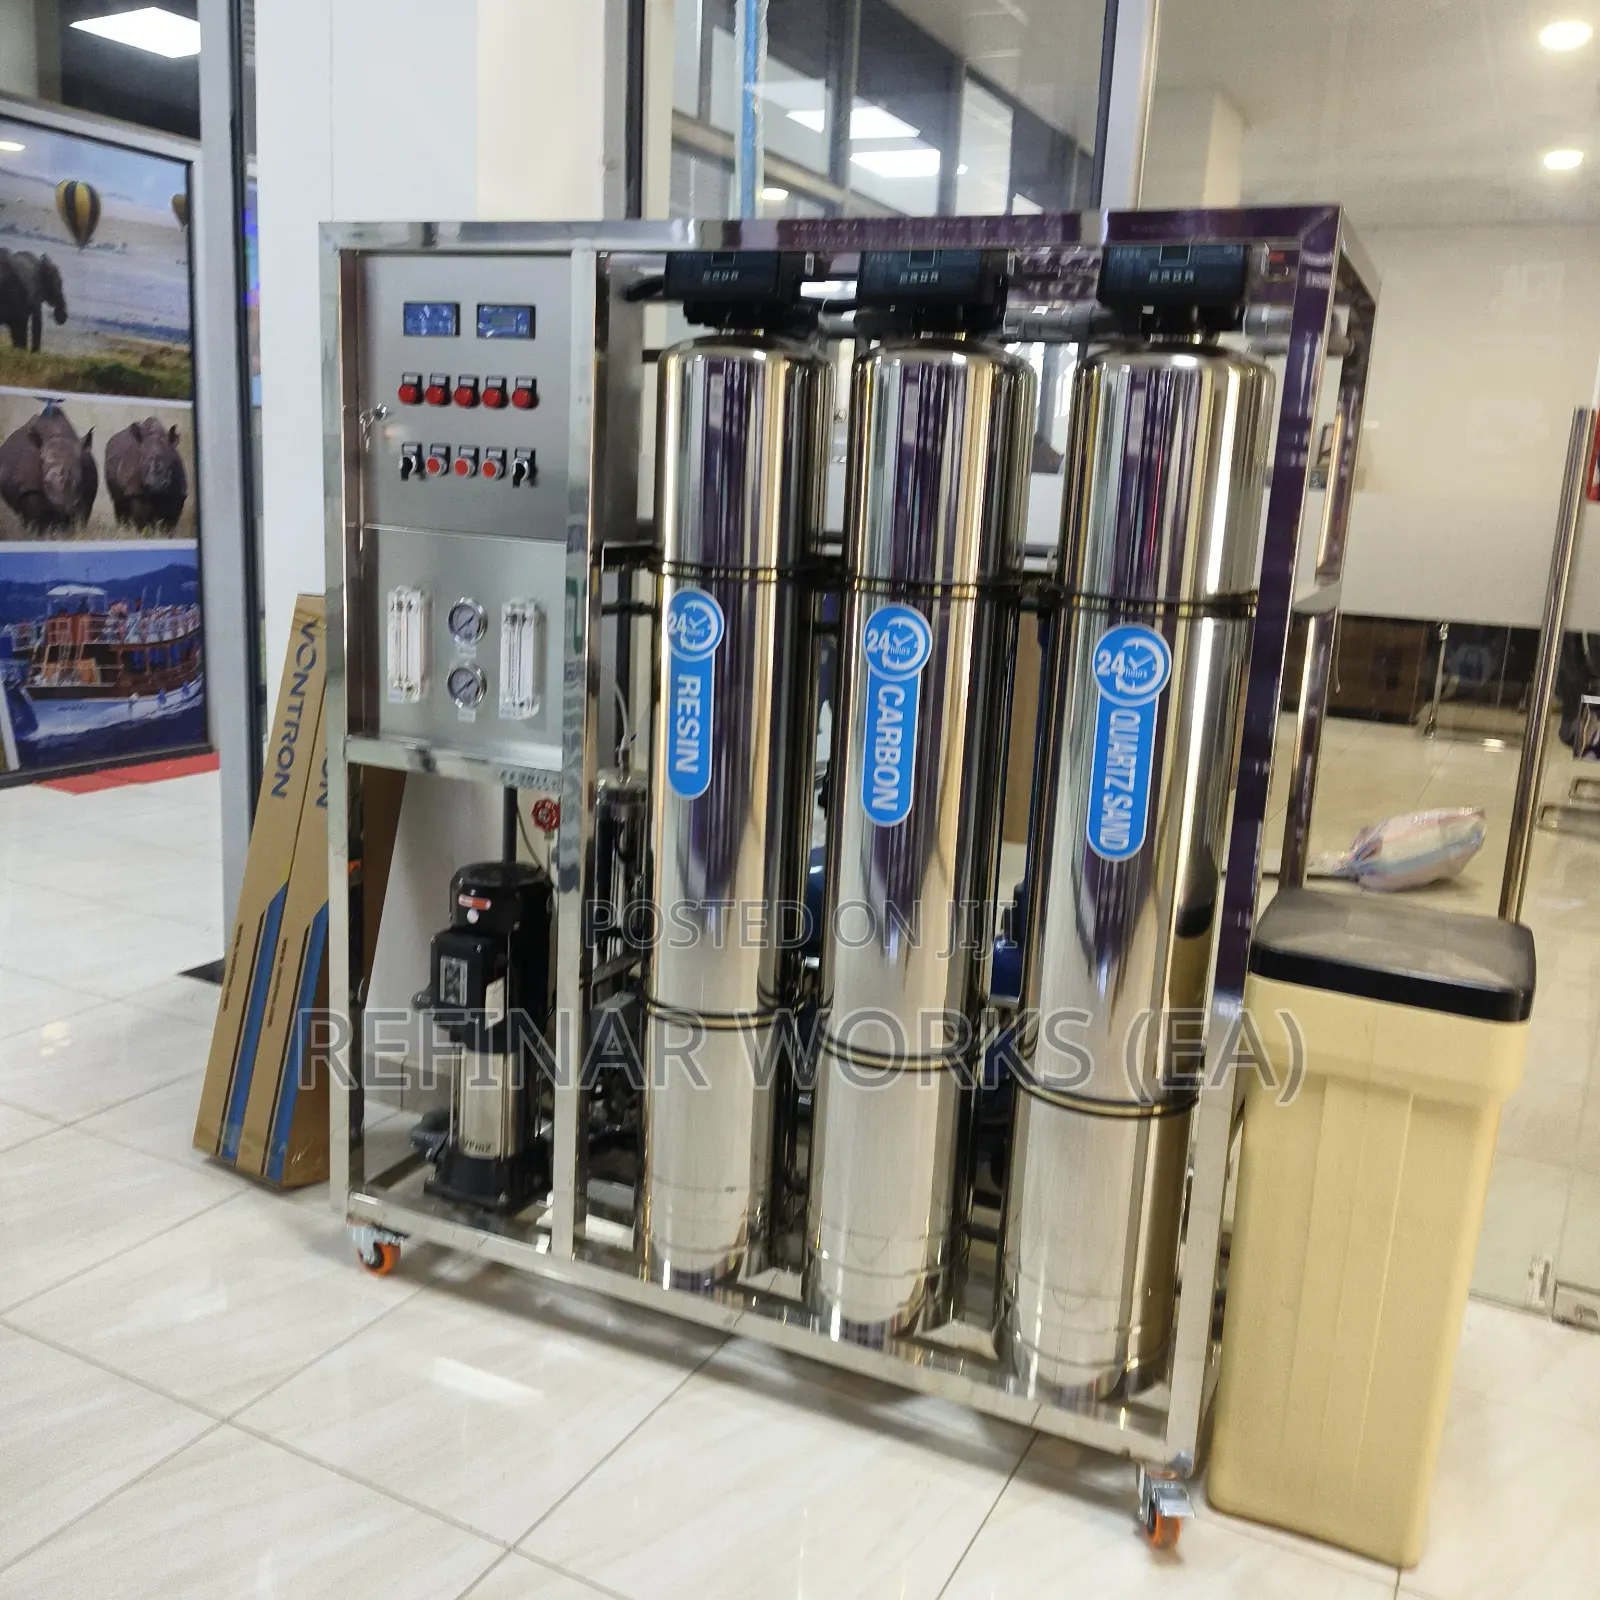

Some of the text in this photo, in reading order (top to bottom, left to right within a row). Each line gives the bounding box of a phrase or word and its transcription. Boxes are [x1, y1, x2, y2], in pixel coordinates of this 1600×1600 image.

[668, 611, 687, 635] 24
[866, 629, 890, 653] 24
[1096, 649, 1125, 677] 24
[271, 617, 319, 798] VONTRON
[675, 673, 702, 774] RESIN
[872, 684, 905, 812] CARBON
[1100, 708, 1141, 850] QUARTZ SAND
